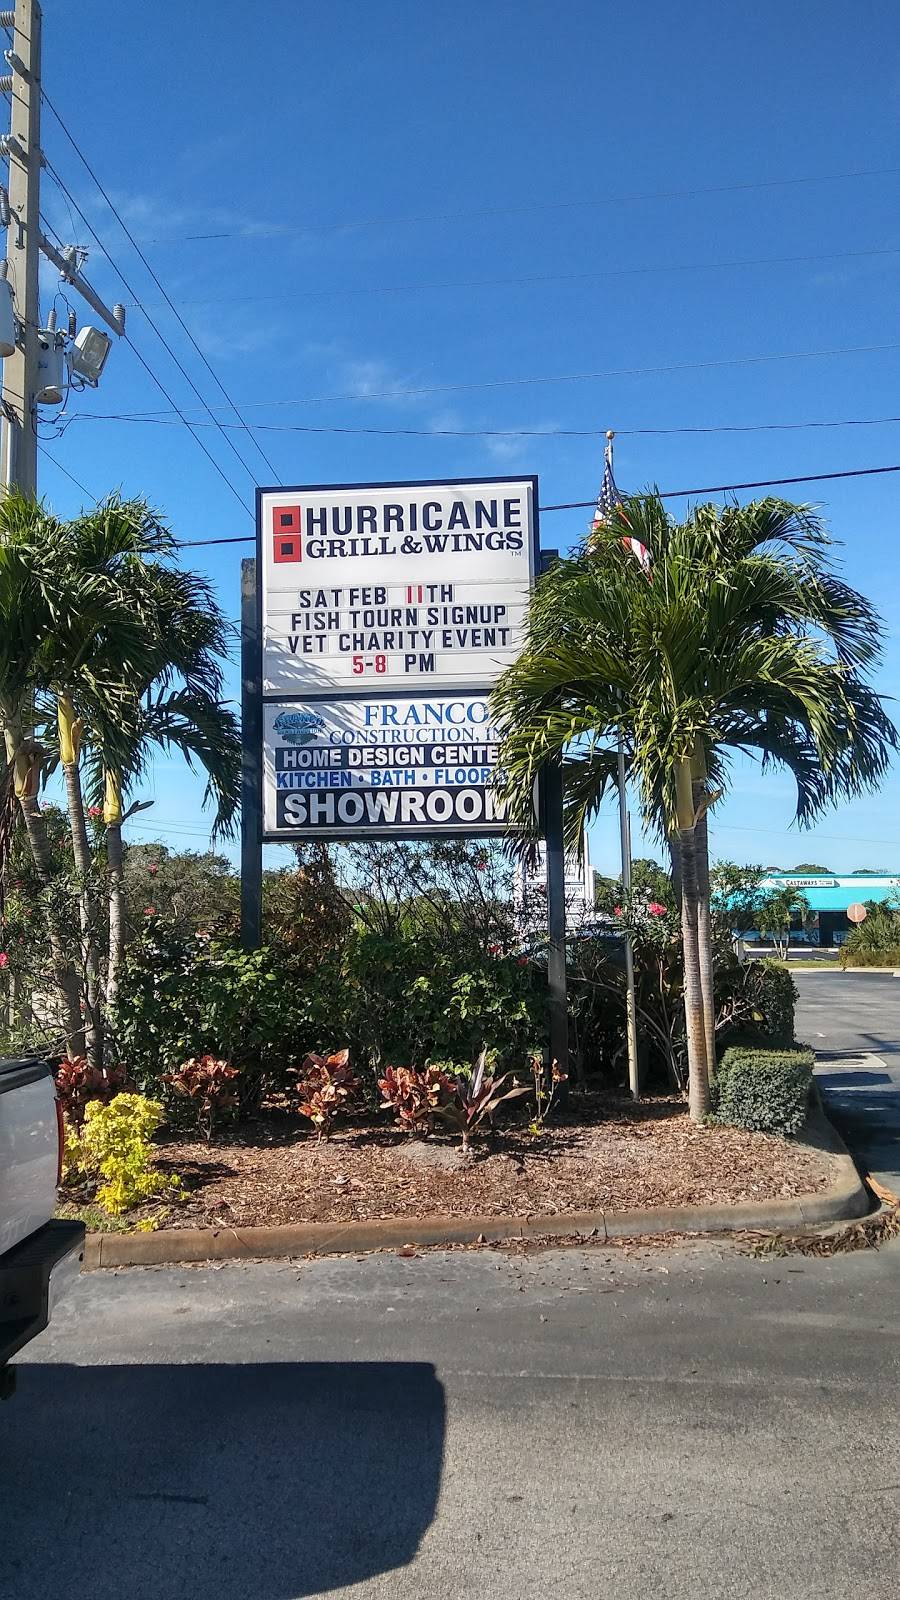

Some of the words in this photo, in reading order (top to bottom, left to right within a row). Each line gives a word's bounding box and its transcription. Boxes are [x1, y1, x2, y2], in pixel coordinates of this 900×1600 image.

[306, 498, 521, 536] HURRICANE
[300, 589, 343, 609] SAT
[350, 586, 387, 606] FEB
[291, 612, 340, 632] FISH
[349, 608, 418, 629] TOURN
[427, 605, 506, 626] SIGNUP
[288, 635, 327, 654] VET
[339, 631, 434, 652] CHARITY
[442, 628, 510, 648] EVENT
[353, 654, 387, 674] 5-8
[404, 653, 435, 672] PM
[363, 702, 490, 727] FRANCO
[329, 727, 480, 745] CONSTRUCTION,
[484, 727, 507, 742] IN
[283, 749, 342, 768] HOME
[348, 747, 425, 767] DESIGN
[431, 746, 499, 764] CENTE
[276, 770, 352, 788] KITCHEN
[370, 769, 416, 786] BATH
[283, 789, 512, 825] SHOWROOM
